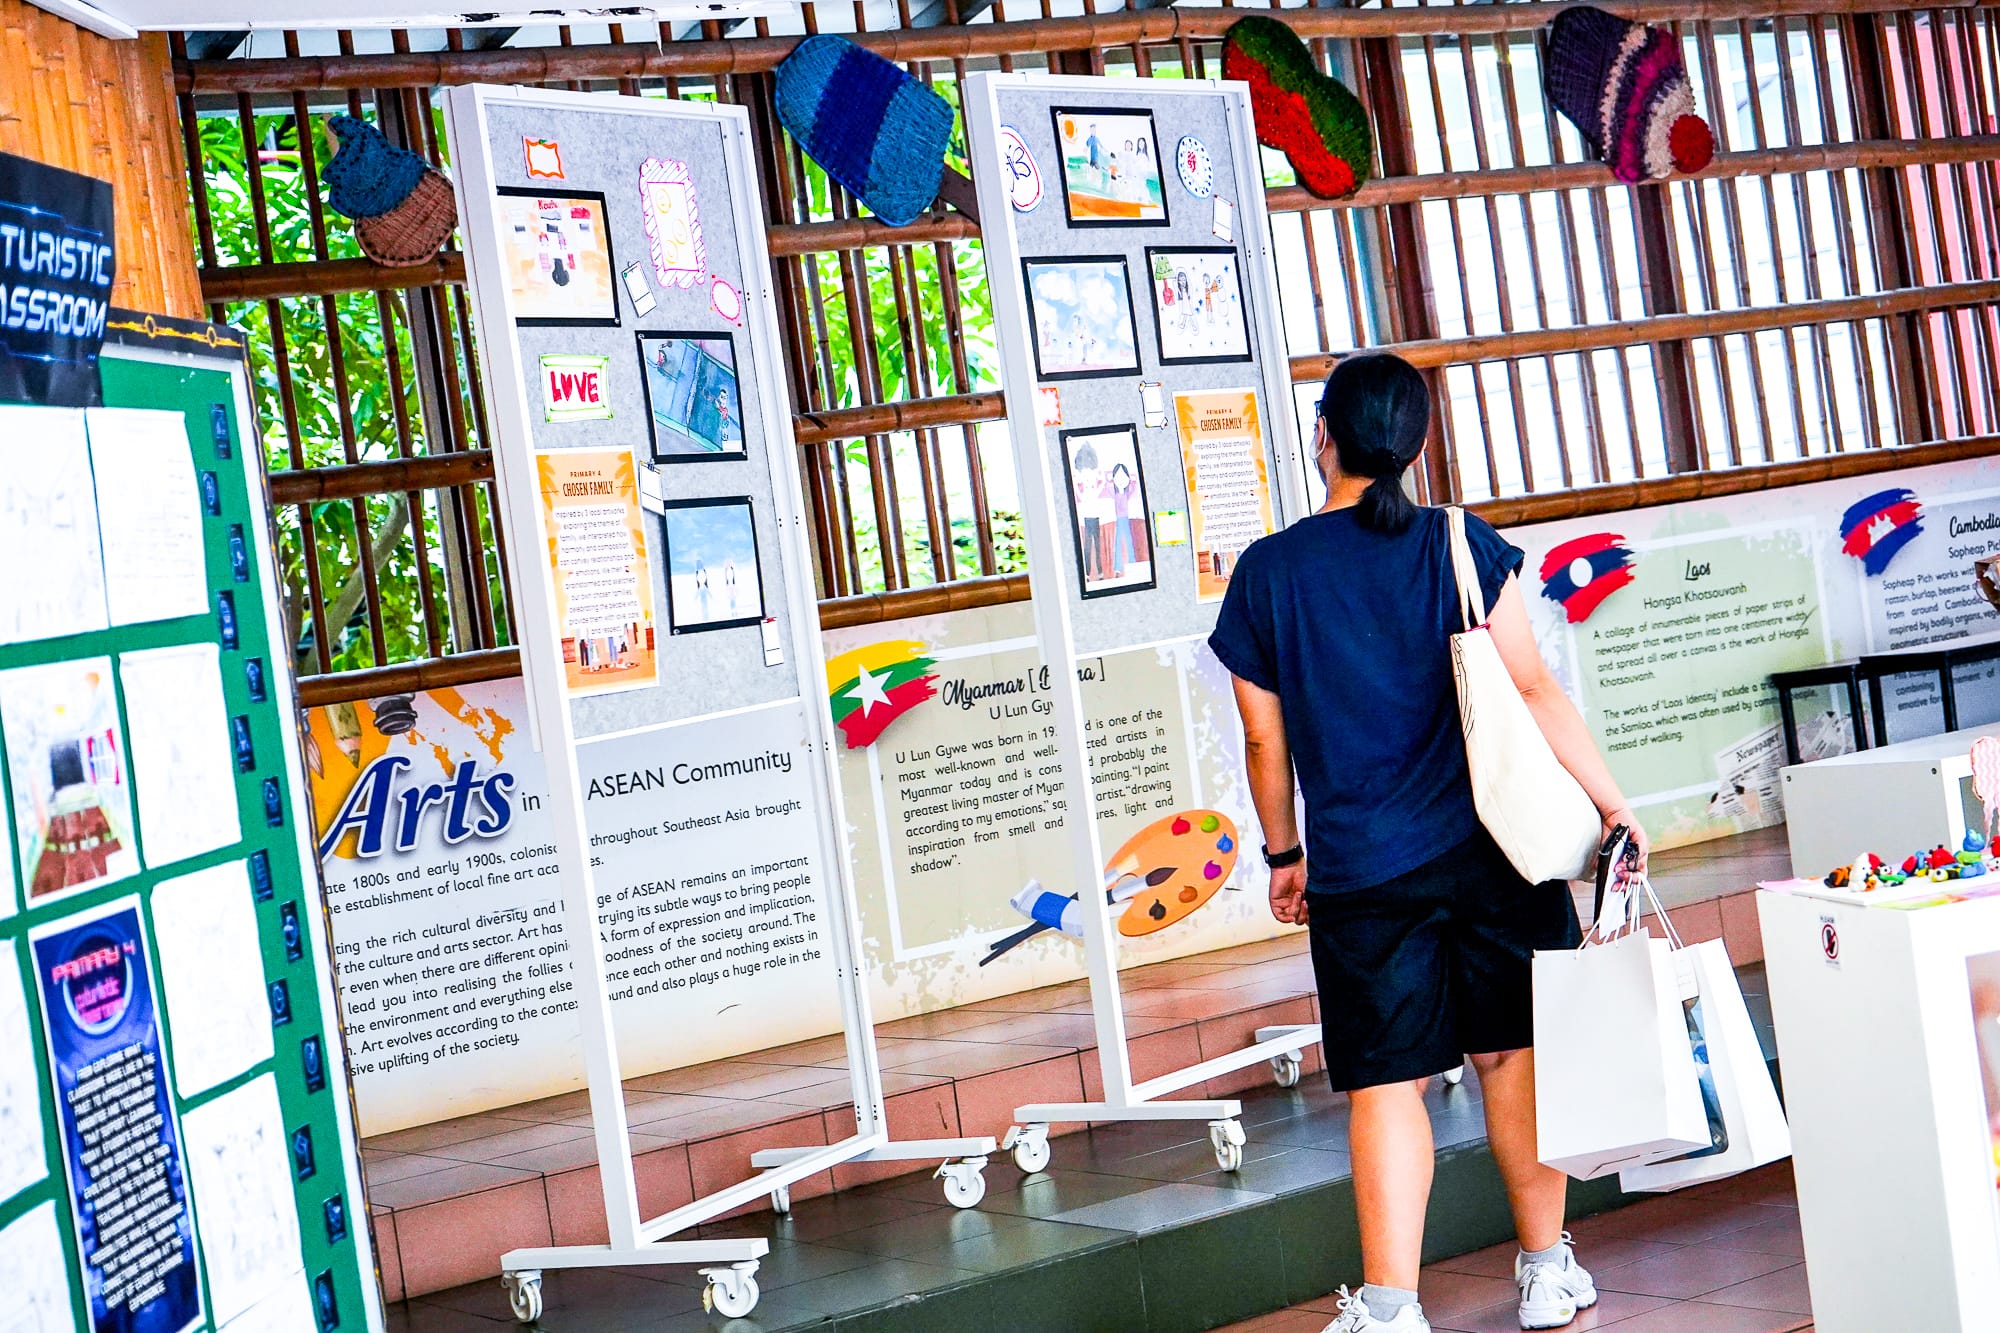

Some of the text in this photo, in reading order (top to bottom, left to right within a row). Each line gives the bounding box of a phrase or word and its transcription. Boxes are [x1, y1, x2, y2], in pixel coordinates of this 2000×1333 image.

[0, 224, 112, 286] TURISTIC
[1200, 417, 1242, 432] CHOSEN FAMILY
[562, 480, 614, 497] CHOSEN FAMILY
[1685, 559, 1711, 581] Laos
[942, 677, 1025, 710] Myanmar
[1005, 705, 1027, 717] Lun
[1108, 709, 1162, 727] one of the
[1116, 731, 1147, 743] artists
[899, 750, 1024, 782] most well-known and
[910, 735, 1023, 761] Lun Gywe was born
[1101, 748, 1144, 767] probably
[1151, 744, 1167, 755] the
[588, 751, 791, 800] ASEAN Community
[901, 769, 1017, 802] Myanmar today and
[1144, 762, 1170, 777] paint
[319, 755, 541, 863] Arts in
[590, 800, 801, 846] throughout Southeast Asia brought
[904, 785, 1033, 822] greatest living master of
[1125, 795, 1173, 816] light and
[906, 820, 959, 837] according
[908, 816, 1063, 856] inspiration from smell and
[346, 888, 434, 911] establishment
[437, 881, 450, 894] of
[454, 875, 484, 891] local
[488, 873, 510, 885] fine
[514, 869, 534, 880] art
[353, 860, 459, 889] 1800s and early
[617, 857, 808, 900] of ASEAN remains important
[654, 874, 811, 913] subtle ways to bring people
[366, 936, 387, 949] the
[393, 929, 416, 944] rich
[422, 918, 471, 938] cultural
[476, 911, 527, 927] diversity
[533, 902, 556, 917] and
[611, 904, 746, 941] form of expression and
[660, 912, 815, 951] of the society around. The
[344, 961, 365, 973] the
[369, 953, 413, 969] culture
[417, 944, 440, 959] and
[444, 942, 469, 954] arts
[473, 934, 513, 949] sector.
[518, 928, 539, 940] Art
[541, 924, 563, 935] has
[633, 935, 804, 976] each other and nothing exists
[348, 963, 563, 1014] lead you into realising the follies
[350, 980, 379, 993] even
[383, 972, 417, 985] when
[421, 965, 455, 979] there
[459, 960, 480, 971] are
[484, 949, 535, 966] different
[637, 949, 820, 995] and also plays huge role the
[345, 981, 572, 1036] the environment and everything else
[361, 1041, 384, 1053] Art
[387, 1031, 432, 1047] evolves
[436, 1017, 497, 1037] according
[501, 1014, 514, 1024] to
[518, 1008, 537, 1020] the
[378, 1033, 520, 1072] uplifting of the society.
